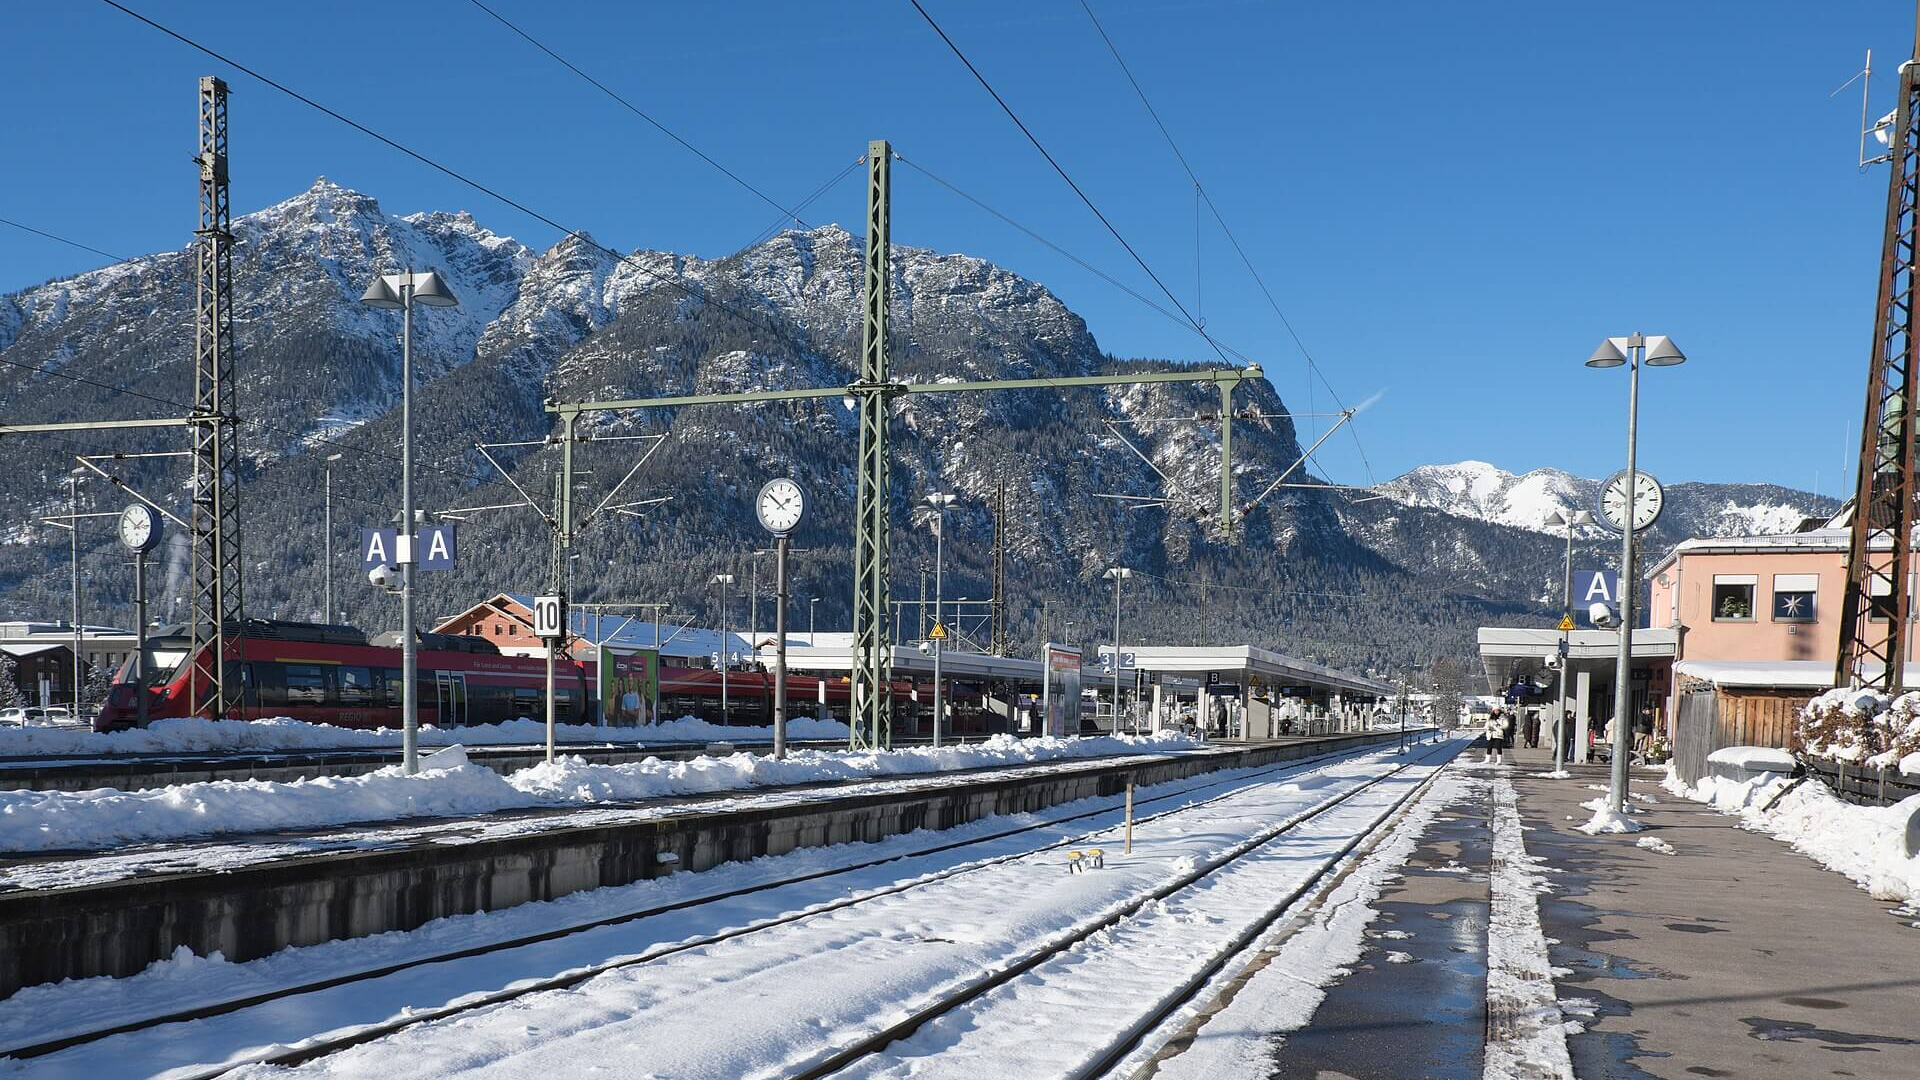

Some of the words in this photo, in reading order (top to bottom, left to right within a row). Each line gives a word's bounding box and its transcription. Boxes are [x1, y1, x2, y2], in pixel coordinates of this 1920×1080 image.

[366, 531, 388, 562] A
[428, 529, 449, 561] A
[1584, 571, 1611, 601] A
[535, 601, 558, 631] 10
[711, 651, 719, 663] 5
[731, 651, 738, 662] 4
[1102, 653, 1110, 665] 3
[1125, 653, 1133, 665] 2
[328, 674, 333, 685] 1
[375, 675, 381, 686] 2
[1211, 673, 1218, 682] B
[1519, 675, 1526, 685] B
